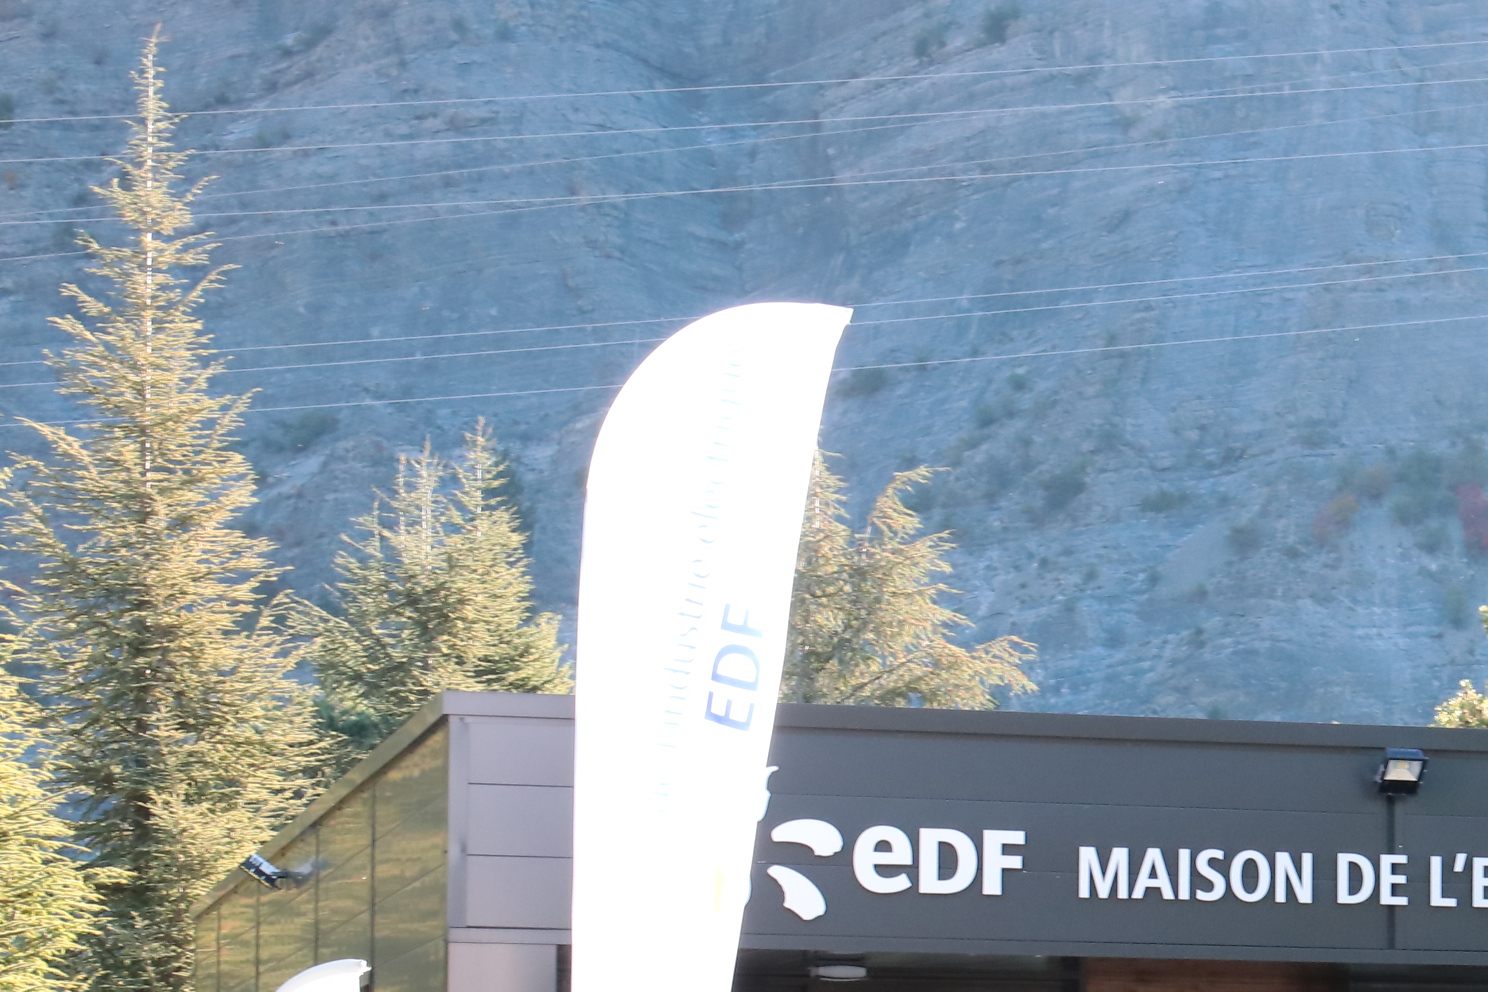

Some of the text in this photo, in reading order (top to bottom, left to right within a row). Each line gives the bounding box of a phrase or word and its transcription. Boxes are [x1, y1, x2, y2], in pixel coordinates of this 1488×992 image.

[704, 602, 764, 732] EDF
[1077, 846, 1314, 904] MAISON
[1336, 852, 1410, 907] DE
